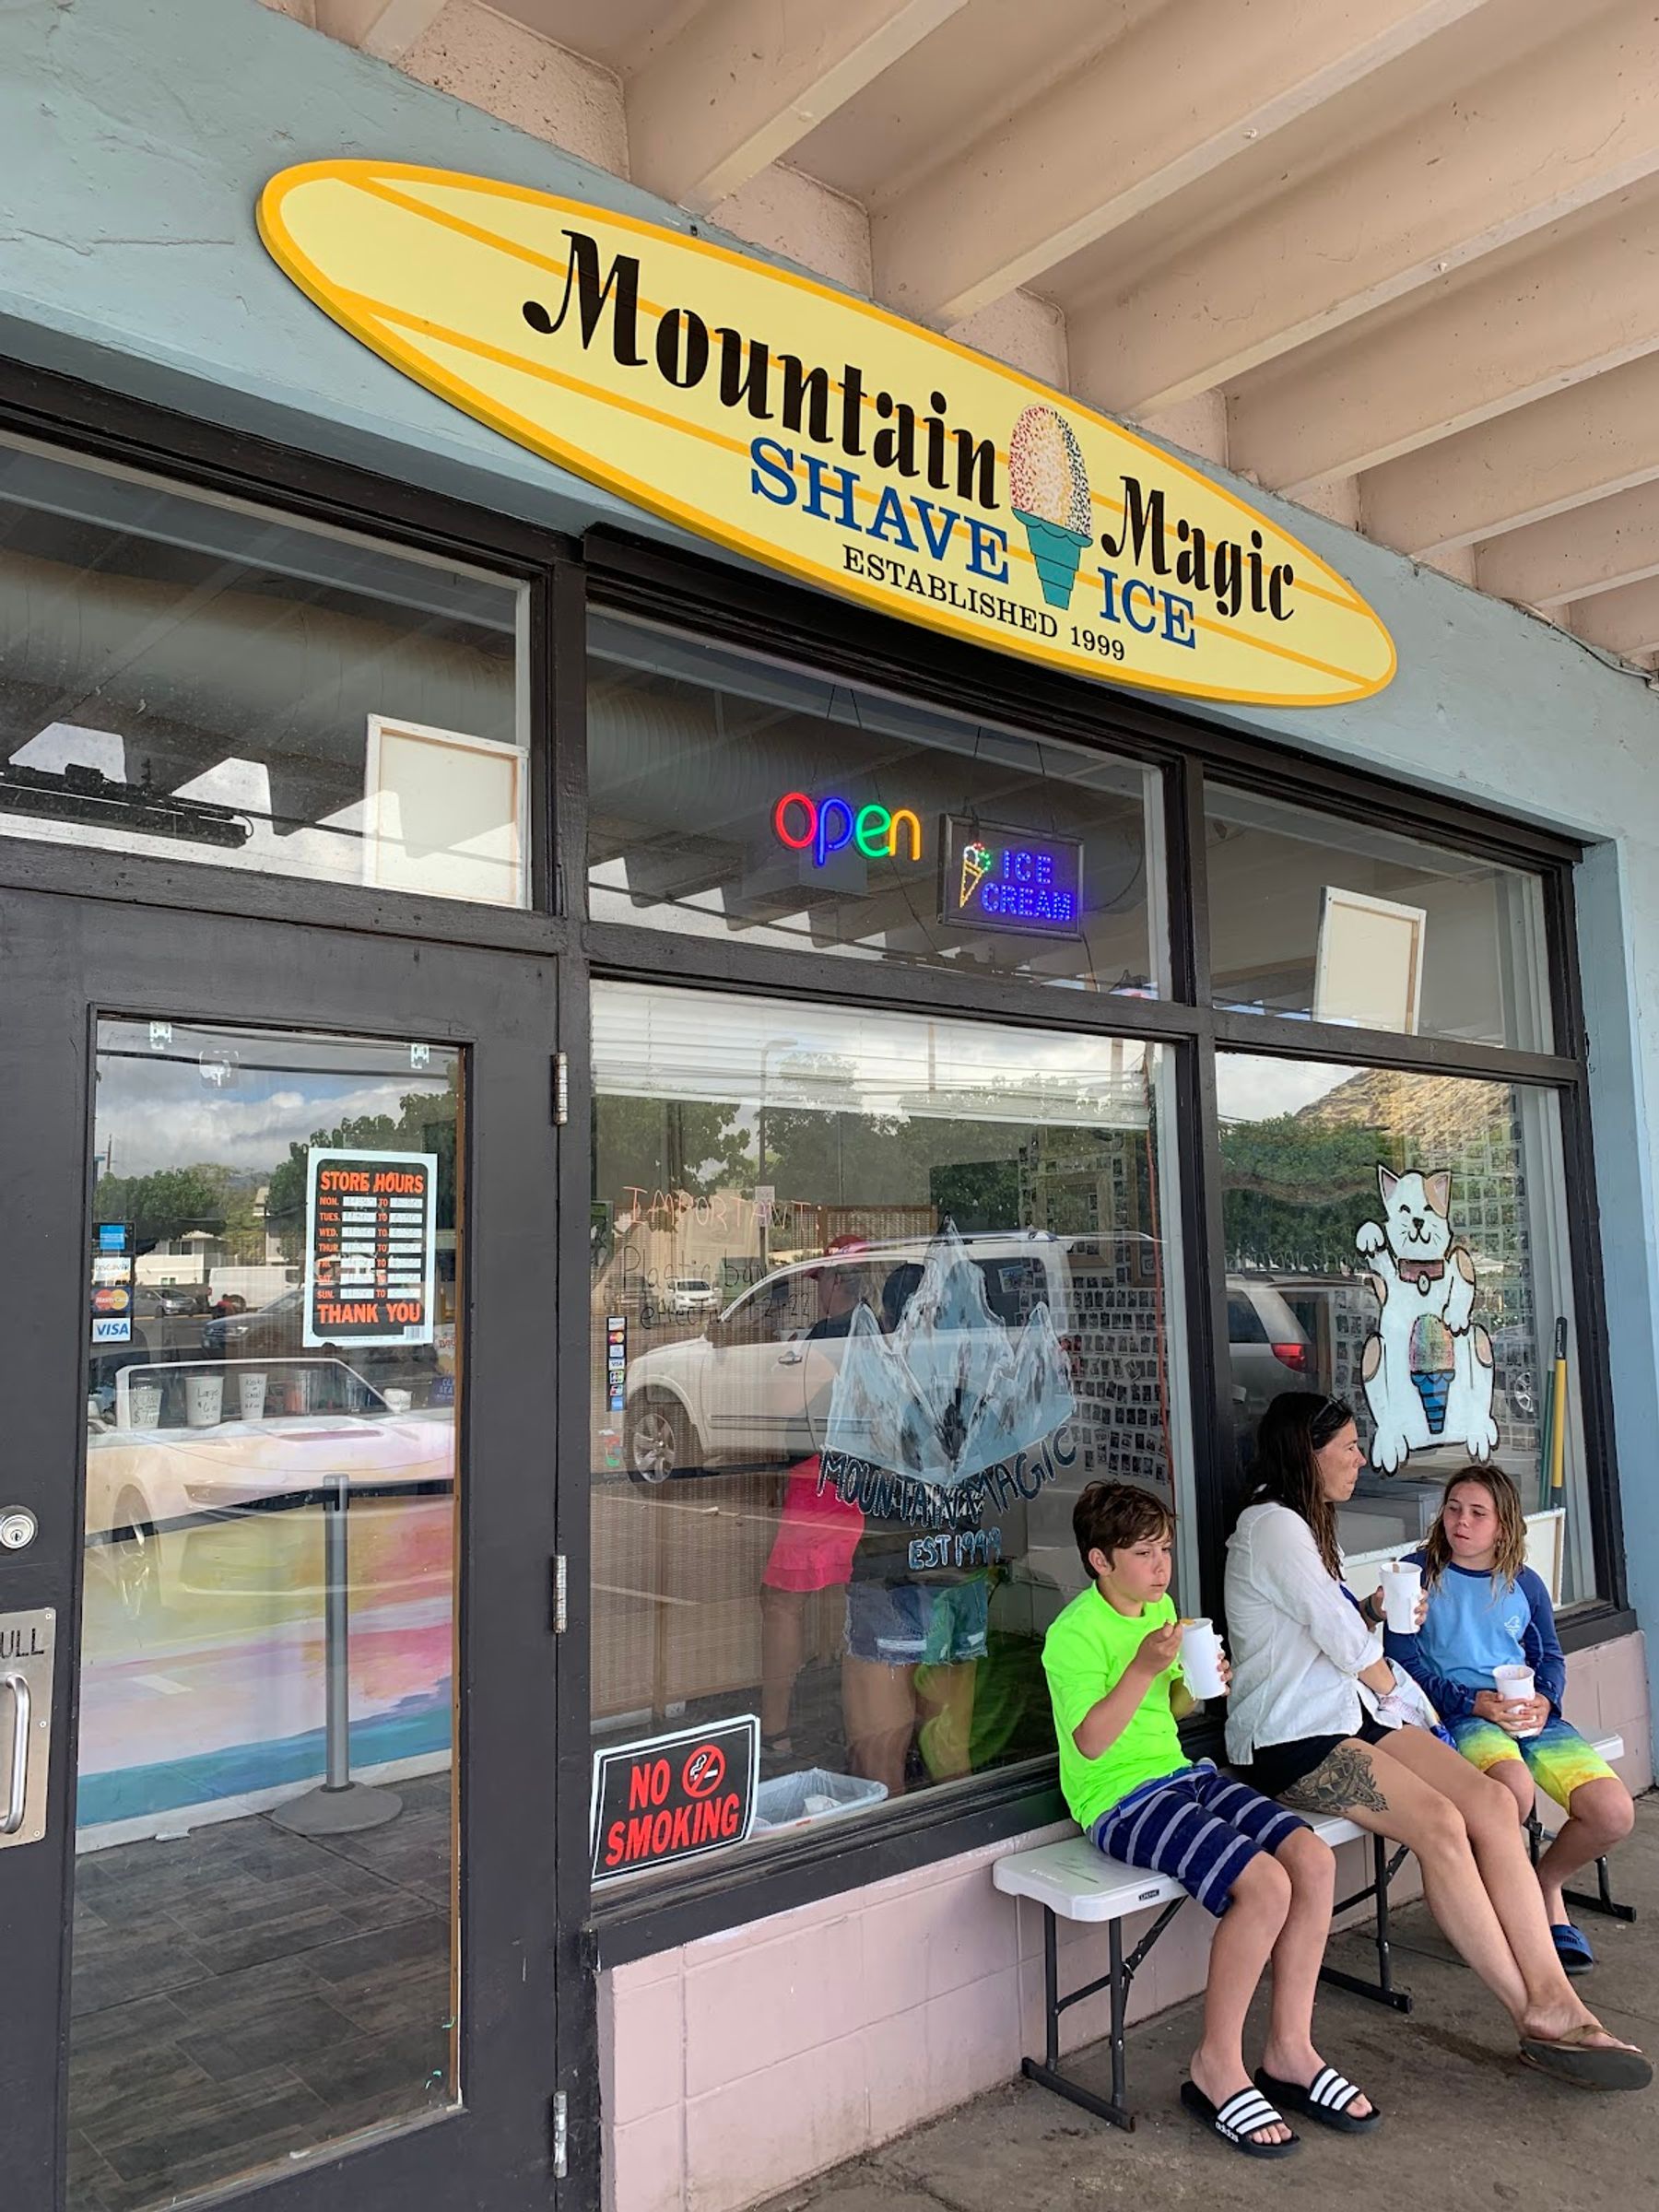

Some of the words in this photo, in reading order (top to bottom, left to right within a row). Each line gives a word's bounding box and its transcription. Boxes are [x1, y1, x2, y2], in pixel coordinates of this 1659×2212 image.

[523, 229, 1000, 510] Mountain
[1101, 476, 1294, 621] Magic
[750, 437, 1010, 585] SHAVE
[1097, 565, 1196, 650] ICE
[841, 544, 1058, 639] ESTABLISHED
[1070, 626, 1125, 661] 1999
[1003, 850, 1053, 885] ICE
[980, 881, 1072, 922] CREAM
[320, 1171, 370, 1192] STORE
[373, 1171, 424, 1194] HOURS
[319, 1197, 339, 1206] MON.
[379, 1198, 388, 1207] TO
[319, 1212, 340, 1222] TUES.
[378, 1213, 388, 1222] TO
[318, 1228, 338, 1237] WED.
[378, 1228, 387, 1237] TO
[377, 1243, 387, 1253] TO
[377, 1258, 386, 1267] TO
[376, 1289, 386, 1299] TO
[317, 1303, 380, 1324] THANK
[385, 1302, 421, 1324] YOU
[97, 1323, 129, 1336] VISA
[817, 1450, 959, 1530] MOUNTAIN
[965, 1425, 1077, 1525] MAGIC
[908, 1534, 951, 1571] EST
[955, 1526, 1002, 1568] 1999
[0, 1628, 44, 1659] ULL
[629, 1759, 671, 1811] NO
[605, 1793, 740, 1866] SMOKING
